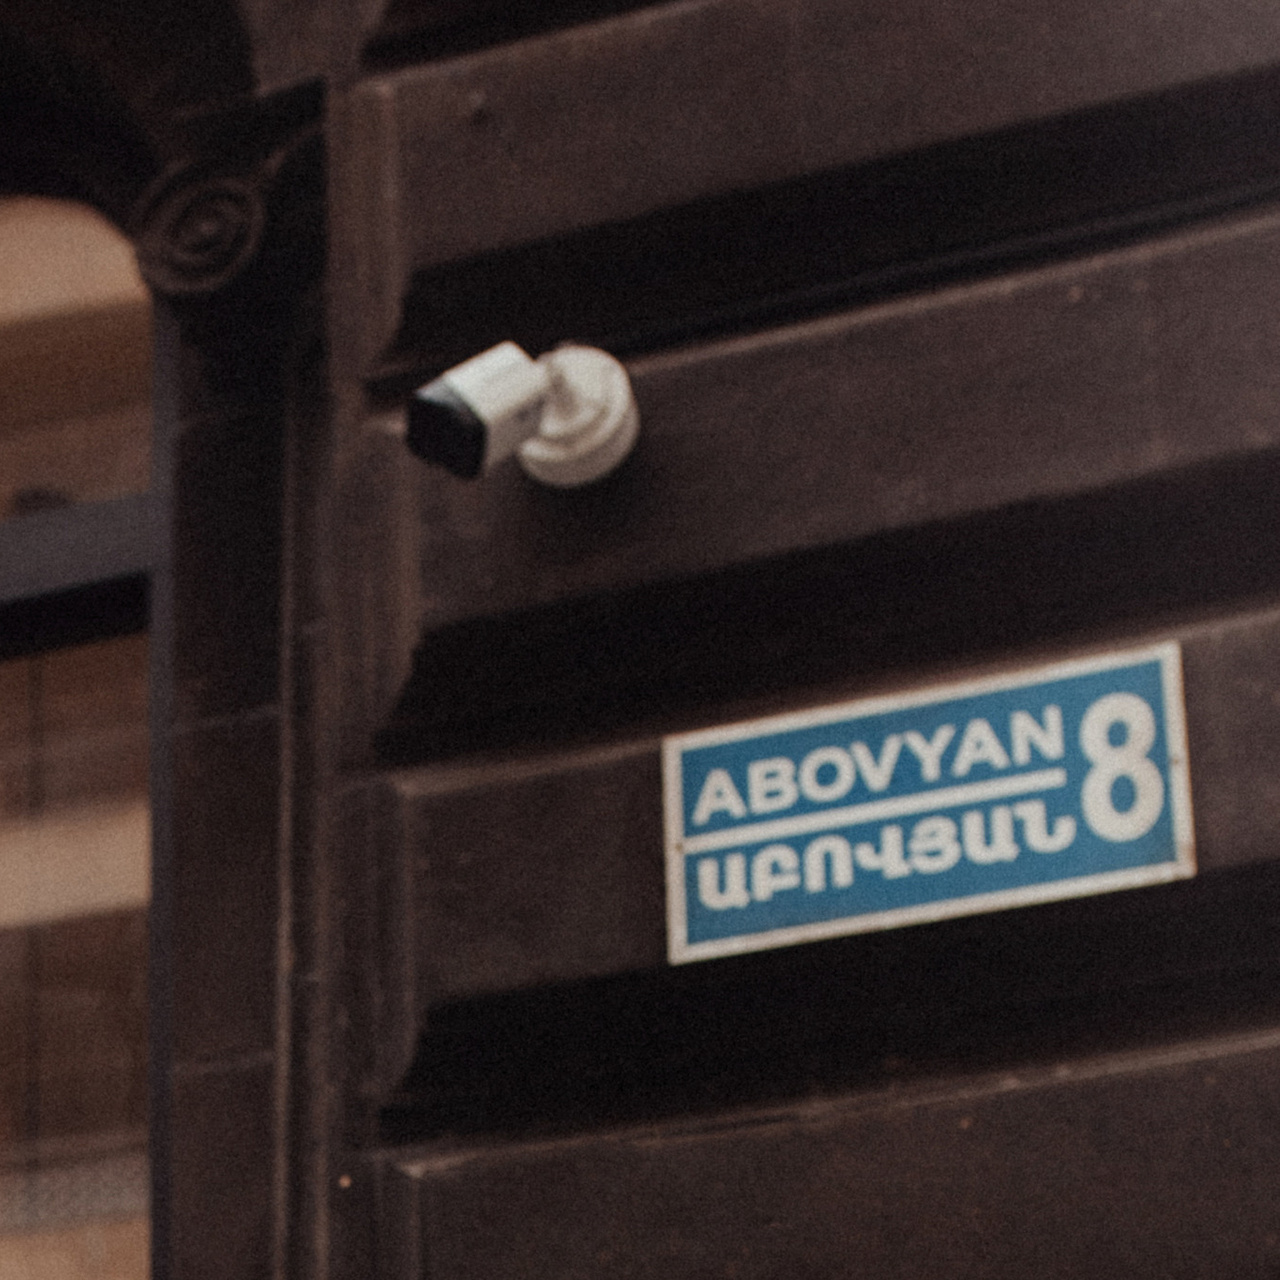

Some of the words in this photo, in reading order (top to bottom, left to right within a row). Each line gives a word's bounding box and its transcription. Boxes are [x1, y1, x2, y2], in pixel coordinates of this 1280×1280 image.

[692, 705, 1065, 825] ABOVYAN
[1079, 692, 1164, 842] 8
[698, 800, 1077, 910] ԱԲՈՎՅԱՆ
